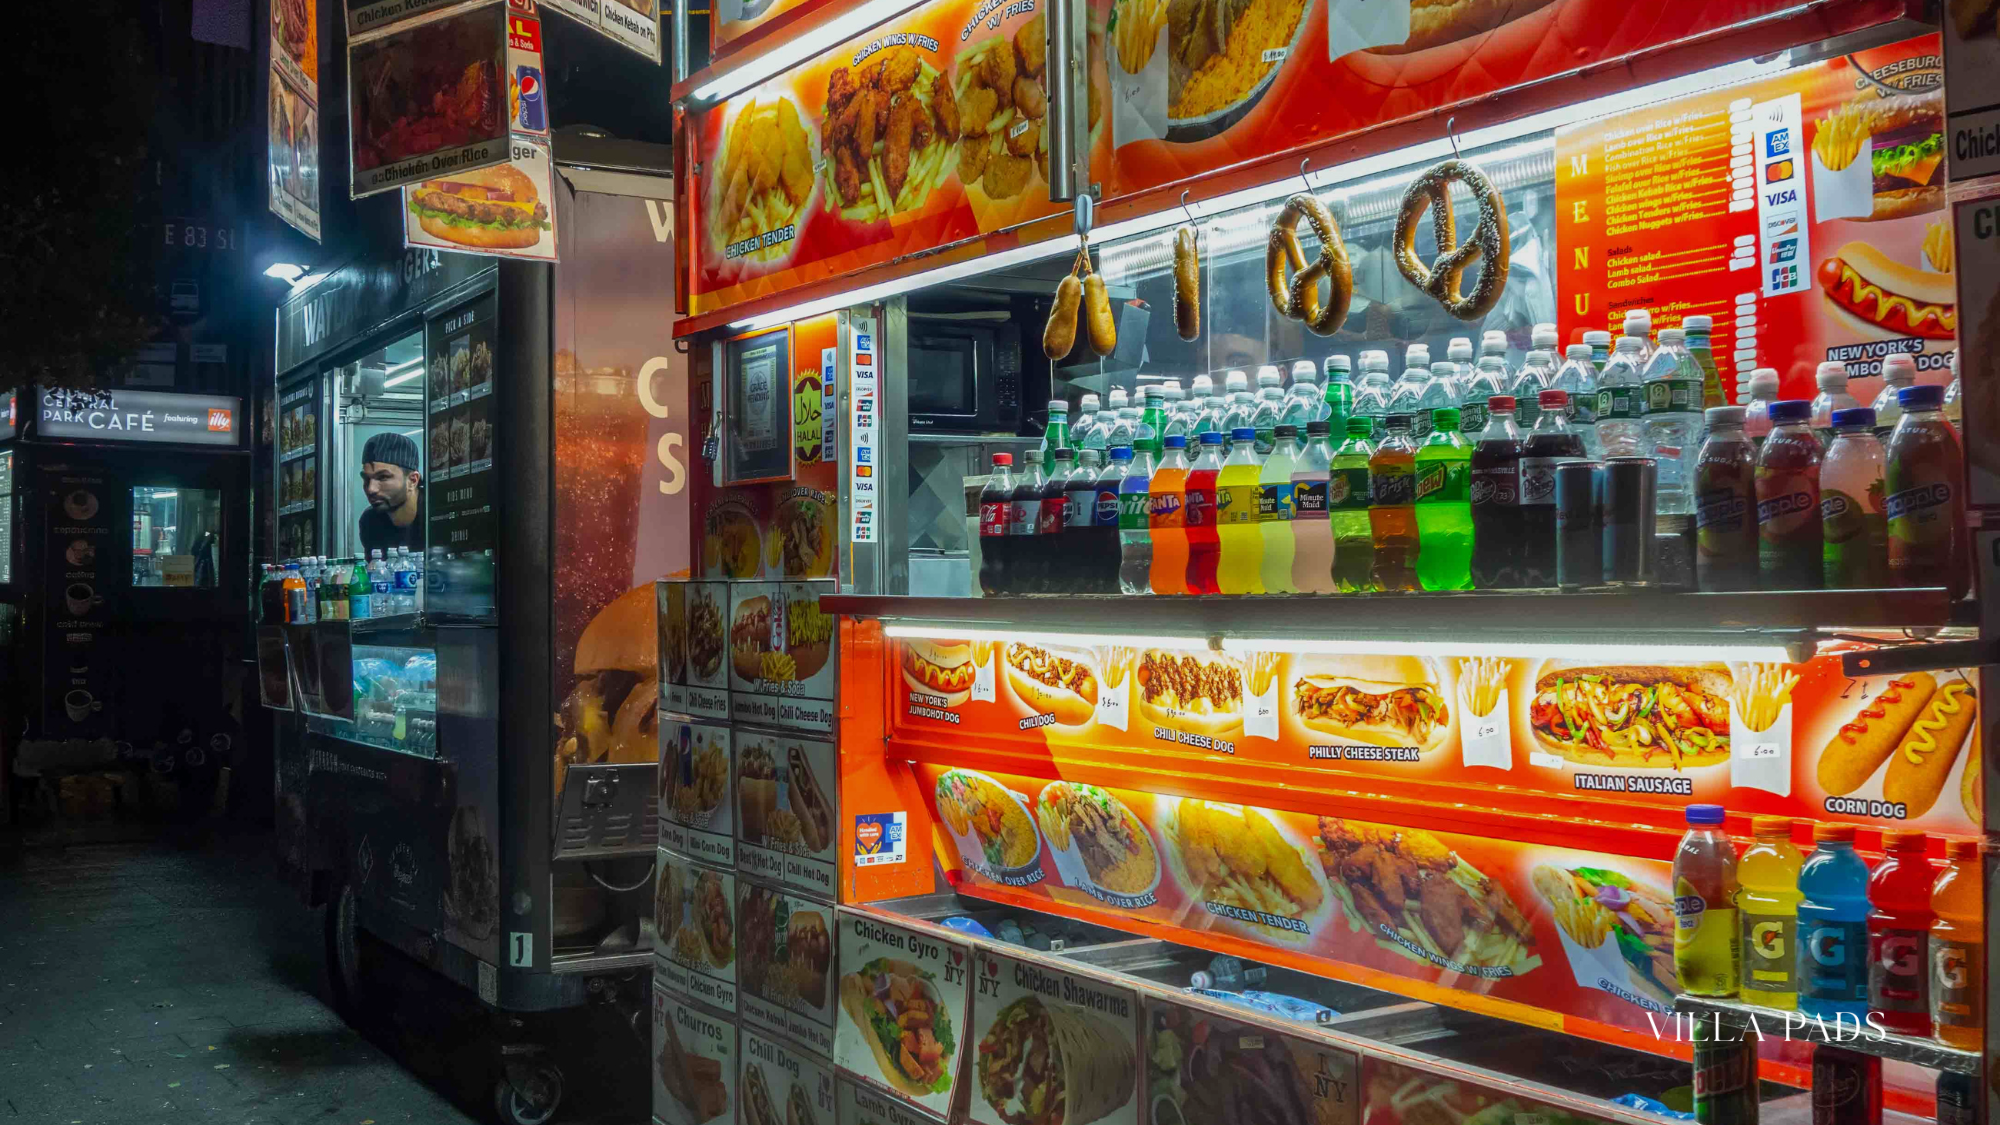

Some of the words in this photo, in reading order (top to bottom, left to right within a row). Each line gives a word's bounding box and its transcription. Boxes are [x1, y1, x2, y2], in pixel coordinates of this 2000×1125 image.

[604, 4, 623, 26] Chicken
[624, 15, 639, 34] Kebab
[1005, 0, 1035, 19] FRIES
[852, 38, 881, 67] CHICKEN
[882, 33, 906, 47] WINGS
[1604, 140, 1626, 153] Lamb
[1646, 130, 1663, 142] Rice
[1665, 124, 1694, 138] w/Fries
[512, 146, 537, 160] ger
[1604, 145, 1654, 162] Combination
[1656, 140, 1673, 151] Rice
[1654, 161, 1671, 173] Rice
[1672, 156, 1702, 170] w/Fries
[1652, 173, 1669, 185] Rice
[1670, 167, 1700, 181] w/Fries
[1606, 190, 1637, 205] Chicken
[1665, 179, 1682, 192] Rice
[1683, 174, 1713, 189] w/Fries
[1765, 189, 1797, 207] VISA
[1606, 201, 1637, 216] Chicken
[1638, 196, 1662, 211] wings
[1663, 190, 1693, 205] w/Fries
[1606, 212, 1637, 226] Chicken
[1638, 205, 1670, 220] Tenders
[1672, 199, 1702, 214] w/Fries
[1606, 222, 1638, 236] Chicken
[1639, 215, 1673, 232] Nuggets
[1674, 210, 1704, 225] w/Fries
[165, 223, 175, 245] E
[185, 225, 207, 248] 83
[725, 238, 761, 260] CHICKEN
[762, 225, 795, 250] TENDER
[1607, 245, 1633, 256] Salads
[1607, 254, 1638, 268] Chicken
[1639, 250, 1661, 263] salad
[1607, 267, 1630, 279] Lamb
[1631, 262, 1652, 275] salad
[1607, 276, 1636, 289] Combo
[1637, 272, 1659, 285] Salad
[1772, 272, 1797, 285] JCB
[1661, 300, 1691, 314] w/Fries
[1828, 346, 1864, 360] NEW
[1865, 338, 1923, 357] YORK'S
[856, 370, 873, 379] VISA
[1847, 361, 1882, 376] MBO
[43, 395, 119, 410] CENRAL
[43, 409, 84, 423] PARK
[88, 411, 154, 432] CAFÉ
[163, 413, 198, 425] featuring
[209, 412, 229, 429] illy
[797, 430, 821, 441] HALAL
[856, 482, 873, 491] VISA
[1099, 502, 1118, 510] PEPSI
[1149, 494, 1181, 511] FANTA
[1299, 494, 1324, 502] Minute
[714, 695, 726, 712] Fries
[909, 692, 924, 703] NEW
[925, 695, 948, 708] YORK'S
[752, 704, 763, 716] Hot
[764, 706, 776, 720] Dog
[780, 704, 793, 719] Chili
[795, 708, 818, 722] Cheese
[820, 711, 832, 727] Dog
[944, 711, 960, 724] DOG
[1019, 716, 1038, 730] CHILI
[1039, 713, 1055, 727] DOG
[1154, 727, 1176, 742] CHILI
[1178, 731, 1211, 750] CHEESE
[1213, 738, 1235, 754] DOG
[1309, 745, 1342, 760] PHILLY
[1344, 746, 1383, 761] CHEESE
[1384, 747, 1419, 762] STEAK
[1574, 774, 1625, 792] ITALIAN
[1628, 776, 1692, 795] SAUSAGE
[1825, 797, 1867, 815] CORN
[1870, 800, 1906, 819] DOG
[717, 842, 730, 859] Dog
[769, 856, 782, 875] Dog
[802, 868, 815, 880] Hot
[816, 871, 830, 885] Dog
[1004, 876, 1027, 887] OVER
[1027, 867, 1046, 884] RICE
[1074, 876, 1104, 903] LAMB
[1106, 894, 1134, 909] OVER
[1135, 892, 1157, 909] RICE
[1205, 900, 1257, 924] CHICKEN
[1258, 911, 1309, 935] TENDER
[854, 919, 905, 949] Chicken
[908, 935, 939, 961] Gyro
[1379, 921, 1427, 958] CHICKEN
[1427, 951, 1465, 975] WINGS
[1483, 964, 1513, 978] FRIES
[1752, 921, 1785, 960] G
[1810, 927, 1845, 966] G
[1880, 936, 1919, 976] G
[944, 961, 965, 986] NY
[1936, 947, 1967, 989] G
[690, 975, 714, 997] Chicken
[716, 986, 734, 1003] Gyro
[978, 975, 1001, 998] NY
[1014, 963, 1061, 998] Chicken
[1063, 973, 1128, 1019] Shawarma
[1597, 976, 1660, 1013] CHICKEN
[677, 1006, 723, 1041] Churros
[819, 1033, 831, 1053] Dog
[778, 1045, 800, 1078] Dog
[1313, 1074, 1348, 1103] NY
[855, 1089, 885, 1119] Lamb
